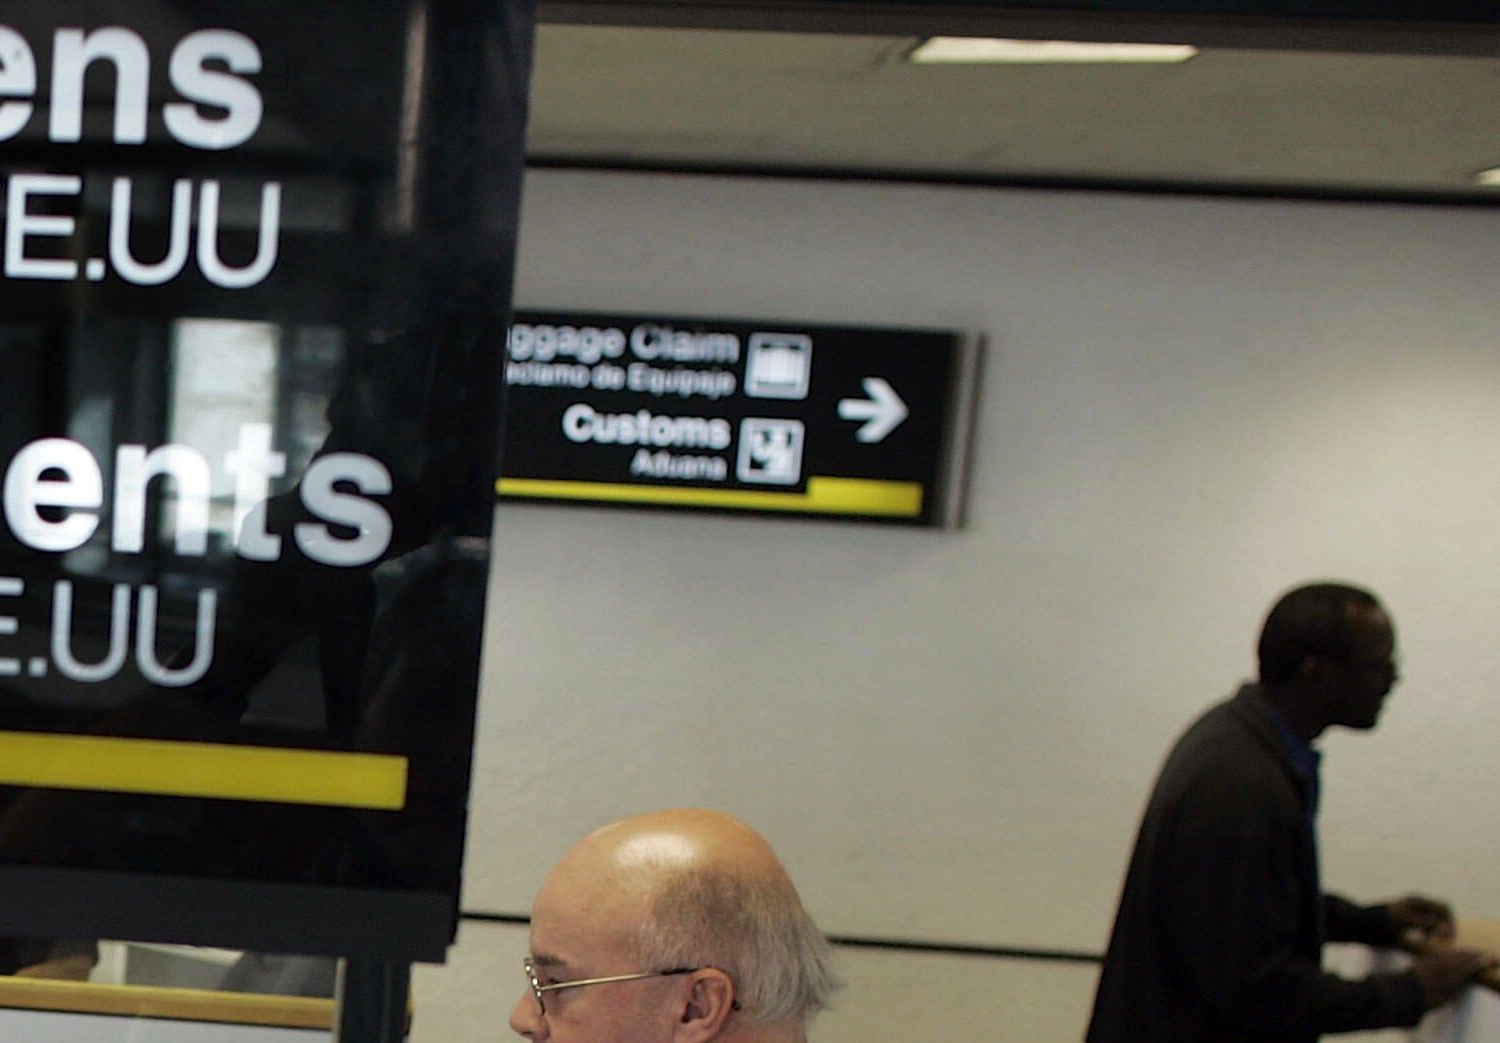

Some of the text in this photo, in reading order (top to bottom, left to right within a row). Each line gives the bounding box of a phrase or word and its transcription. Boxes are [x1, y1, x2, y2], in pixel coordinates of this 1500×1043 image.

[506, 324, 740, 365] ggage Claim
[562, 403, 732, 450] Customs
[630, 449, 728, 480] Aduana
